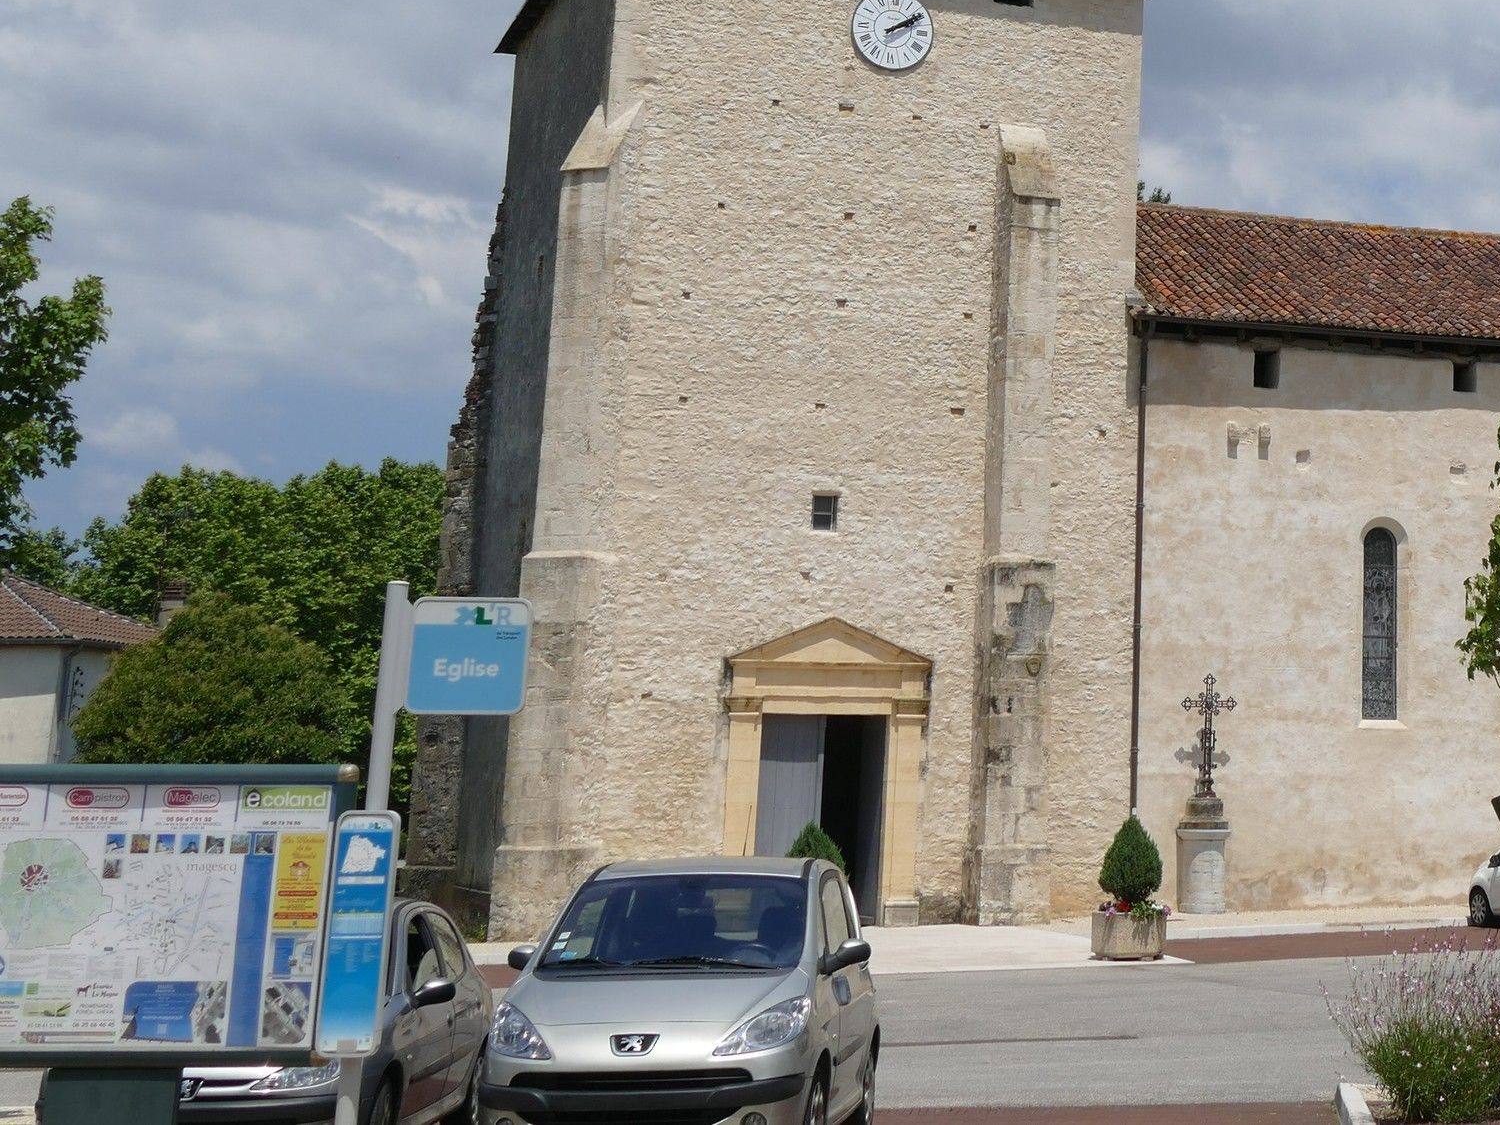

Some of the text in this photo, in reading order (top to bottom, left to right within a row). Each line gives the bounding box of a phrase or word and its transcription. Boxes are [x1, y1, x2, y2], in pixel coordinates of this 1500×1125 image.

[432, 657, 499, 682] Eglise
[71, 792, 128, 803] Campistron
[168, 791, 217, 805] Magelec
[246, 791, 327, 807] ecoland
[186, 863, 237, 874] magescq
